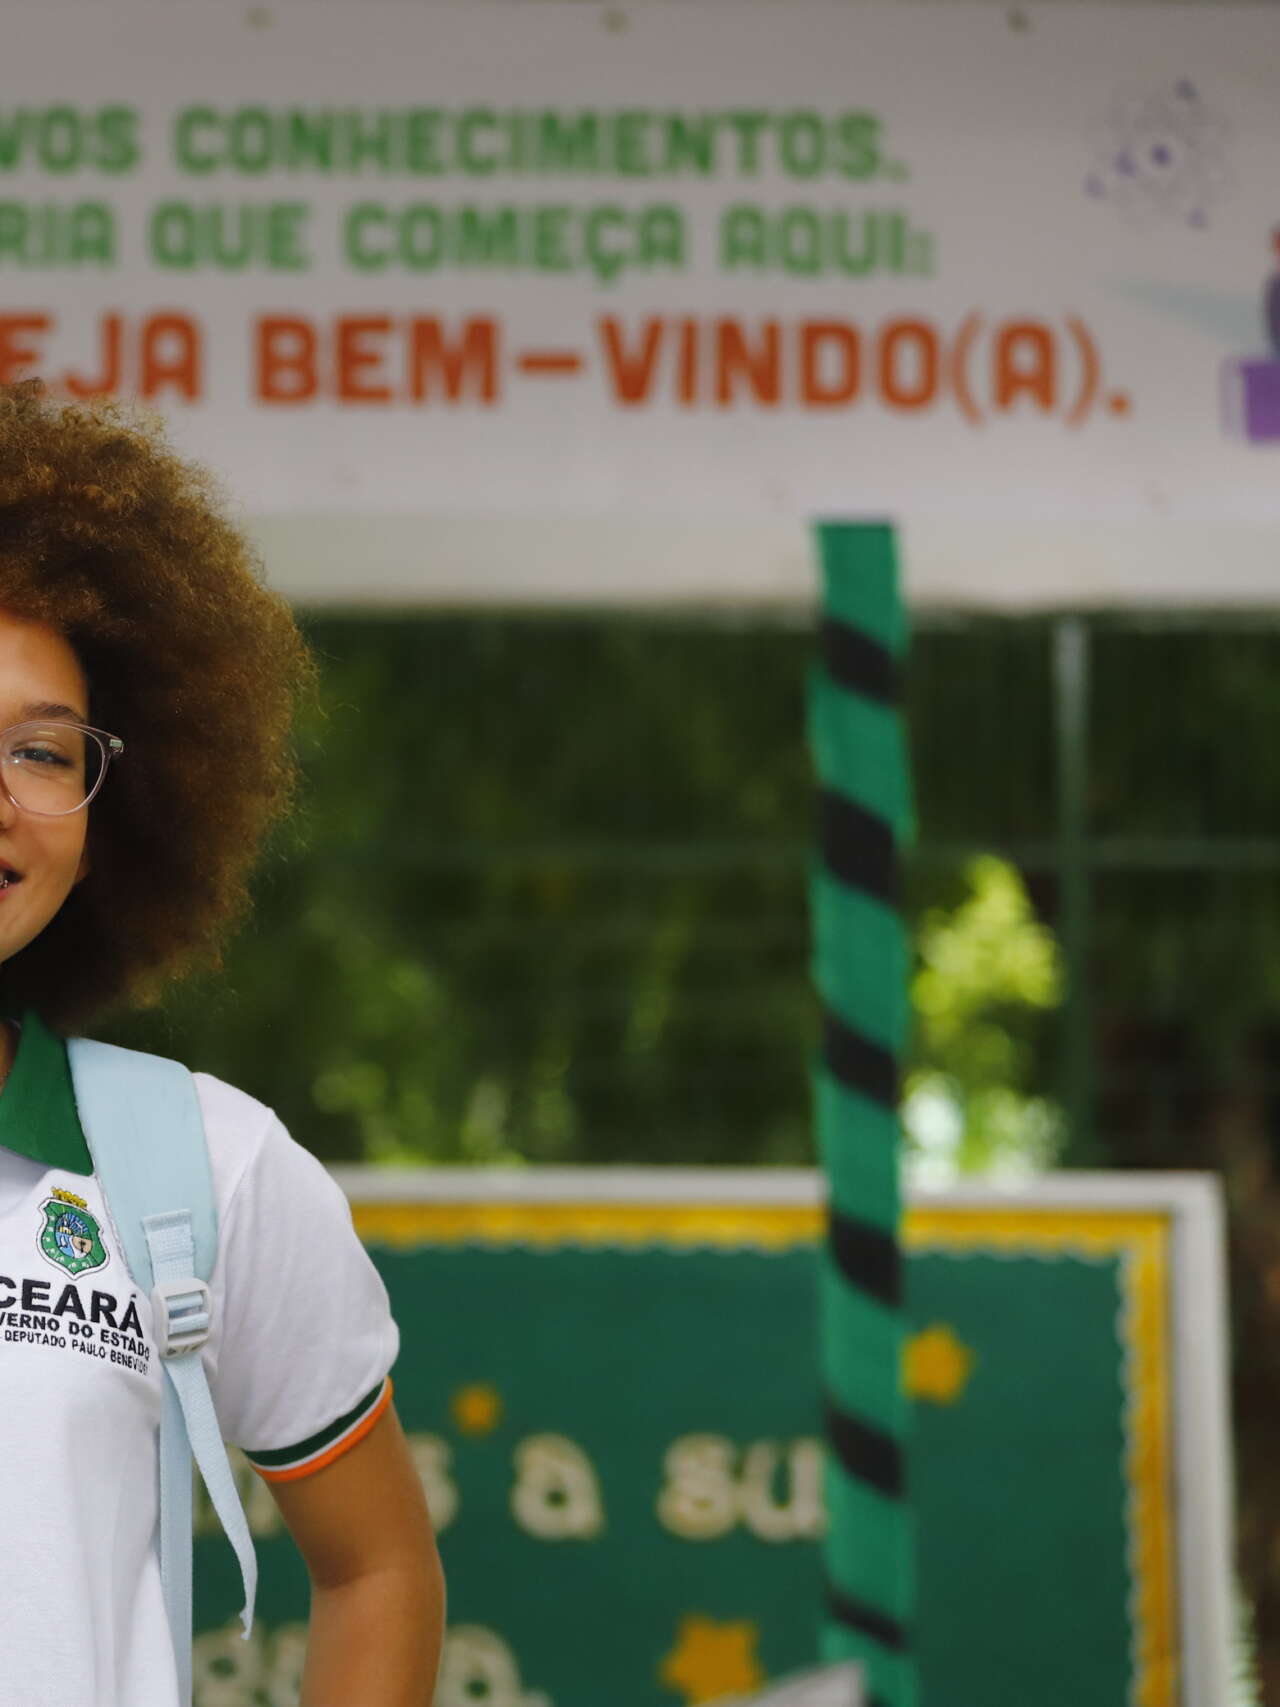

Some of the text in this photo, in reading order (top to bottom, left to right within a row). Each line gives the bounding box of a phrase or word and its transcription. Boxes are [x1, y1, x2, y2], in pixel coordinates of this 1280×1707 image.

[174, 107, 912, 182] CONHECIMENTOS.
[150, 201, 306, 268] QUE
[344, 205, 687, 282] COMEÇA
[718, 207, 937, 278] AQUI:
[254, 312, 1132, 422] BEM-VINDO(A).
[5, 1329, 66, 1348] DEPUTADO
[72, 1340, 105, 1359] PAULO
[69, 1321, 93, 1338] DO
[100, 1328, 150, 1361] ESTADO
[657, 1432, 826, 1541] su
